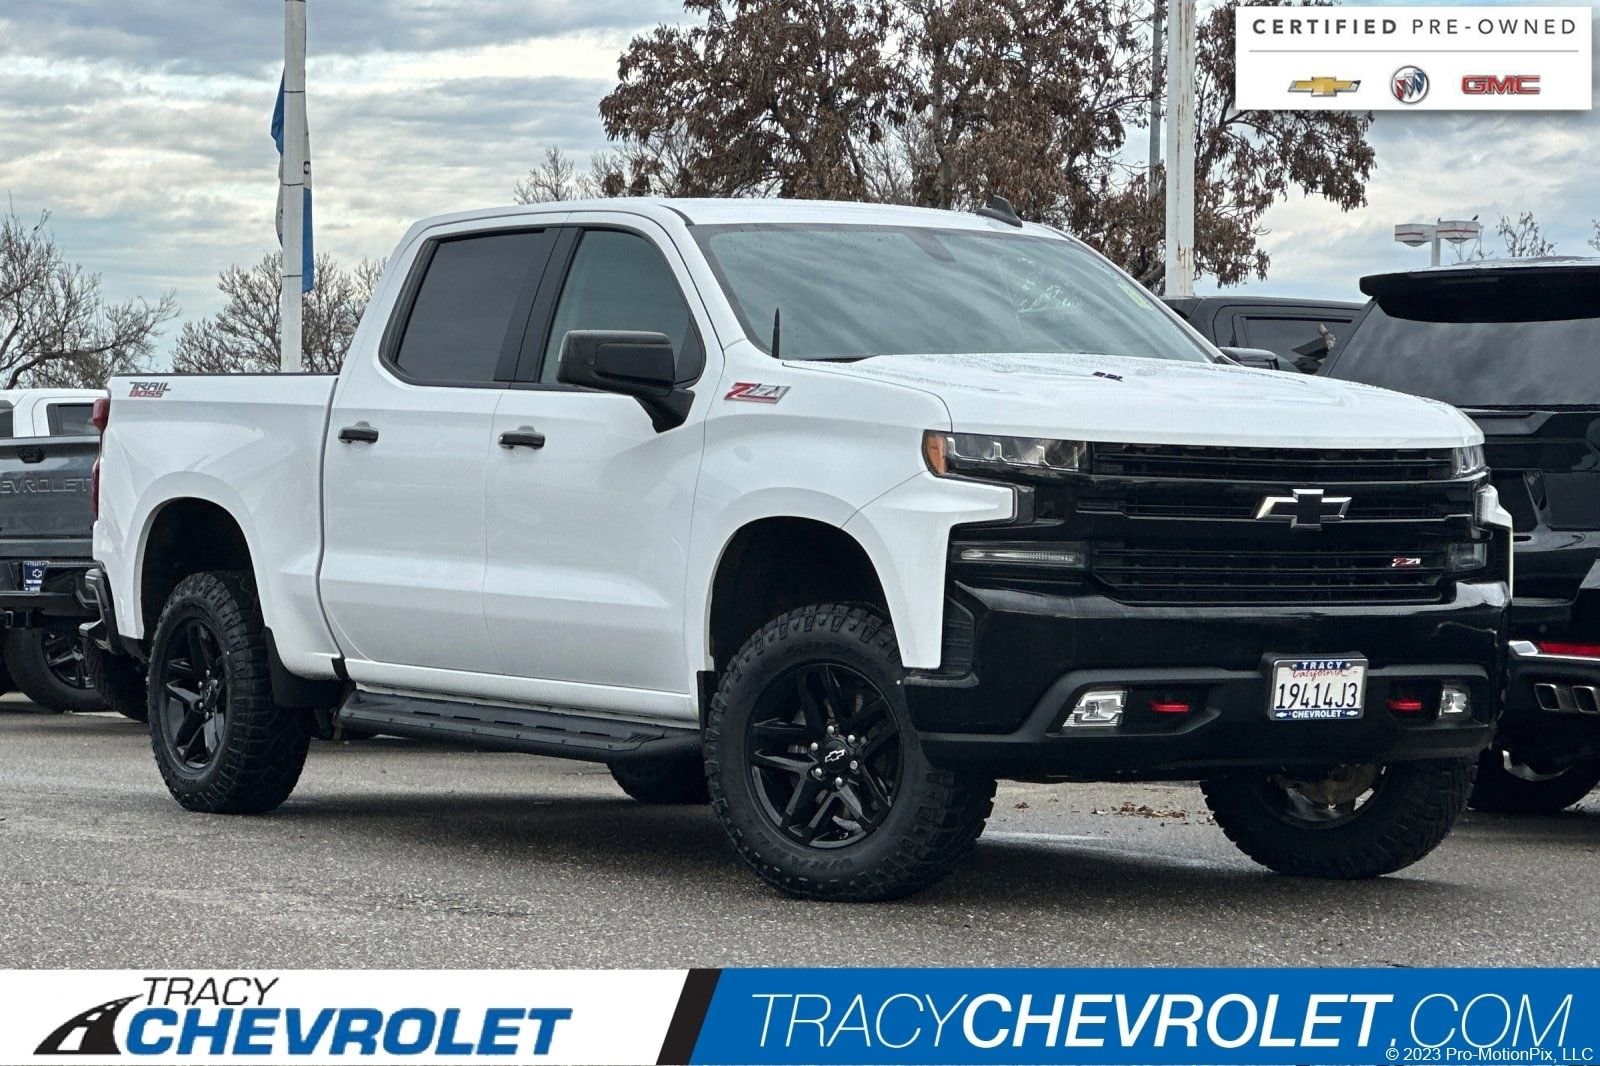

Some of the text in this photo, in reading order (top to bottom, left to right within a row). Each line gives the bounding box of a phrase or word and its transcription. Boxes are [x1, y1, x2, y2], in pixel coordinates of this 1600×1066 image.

[129, 381, 171, 391] TRAIL
[128, 390, 164, 398] BOSS
[1302, 661, 1343, 670] TRACY
[1275, 682, 1358, 709] 19414J3
[1292, 709, 1342, 719] CHEVROLET
